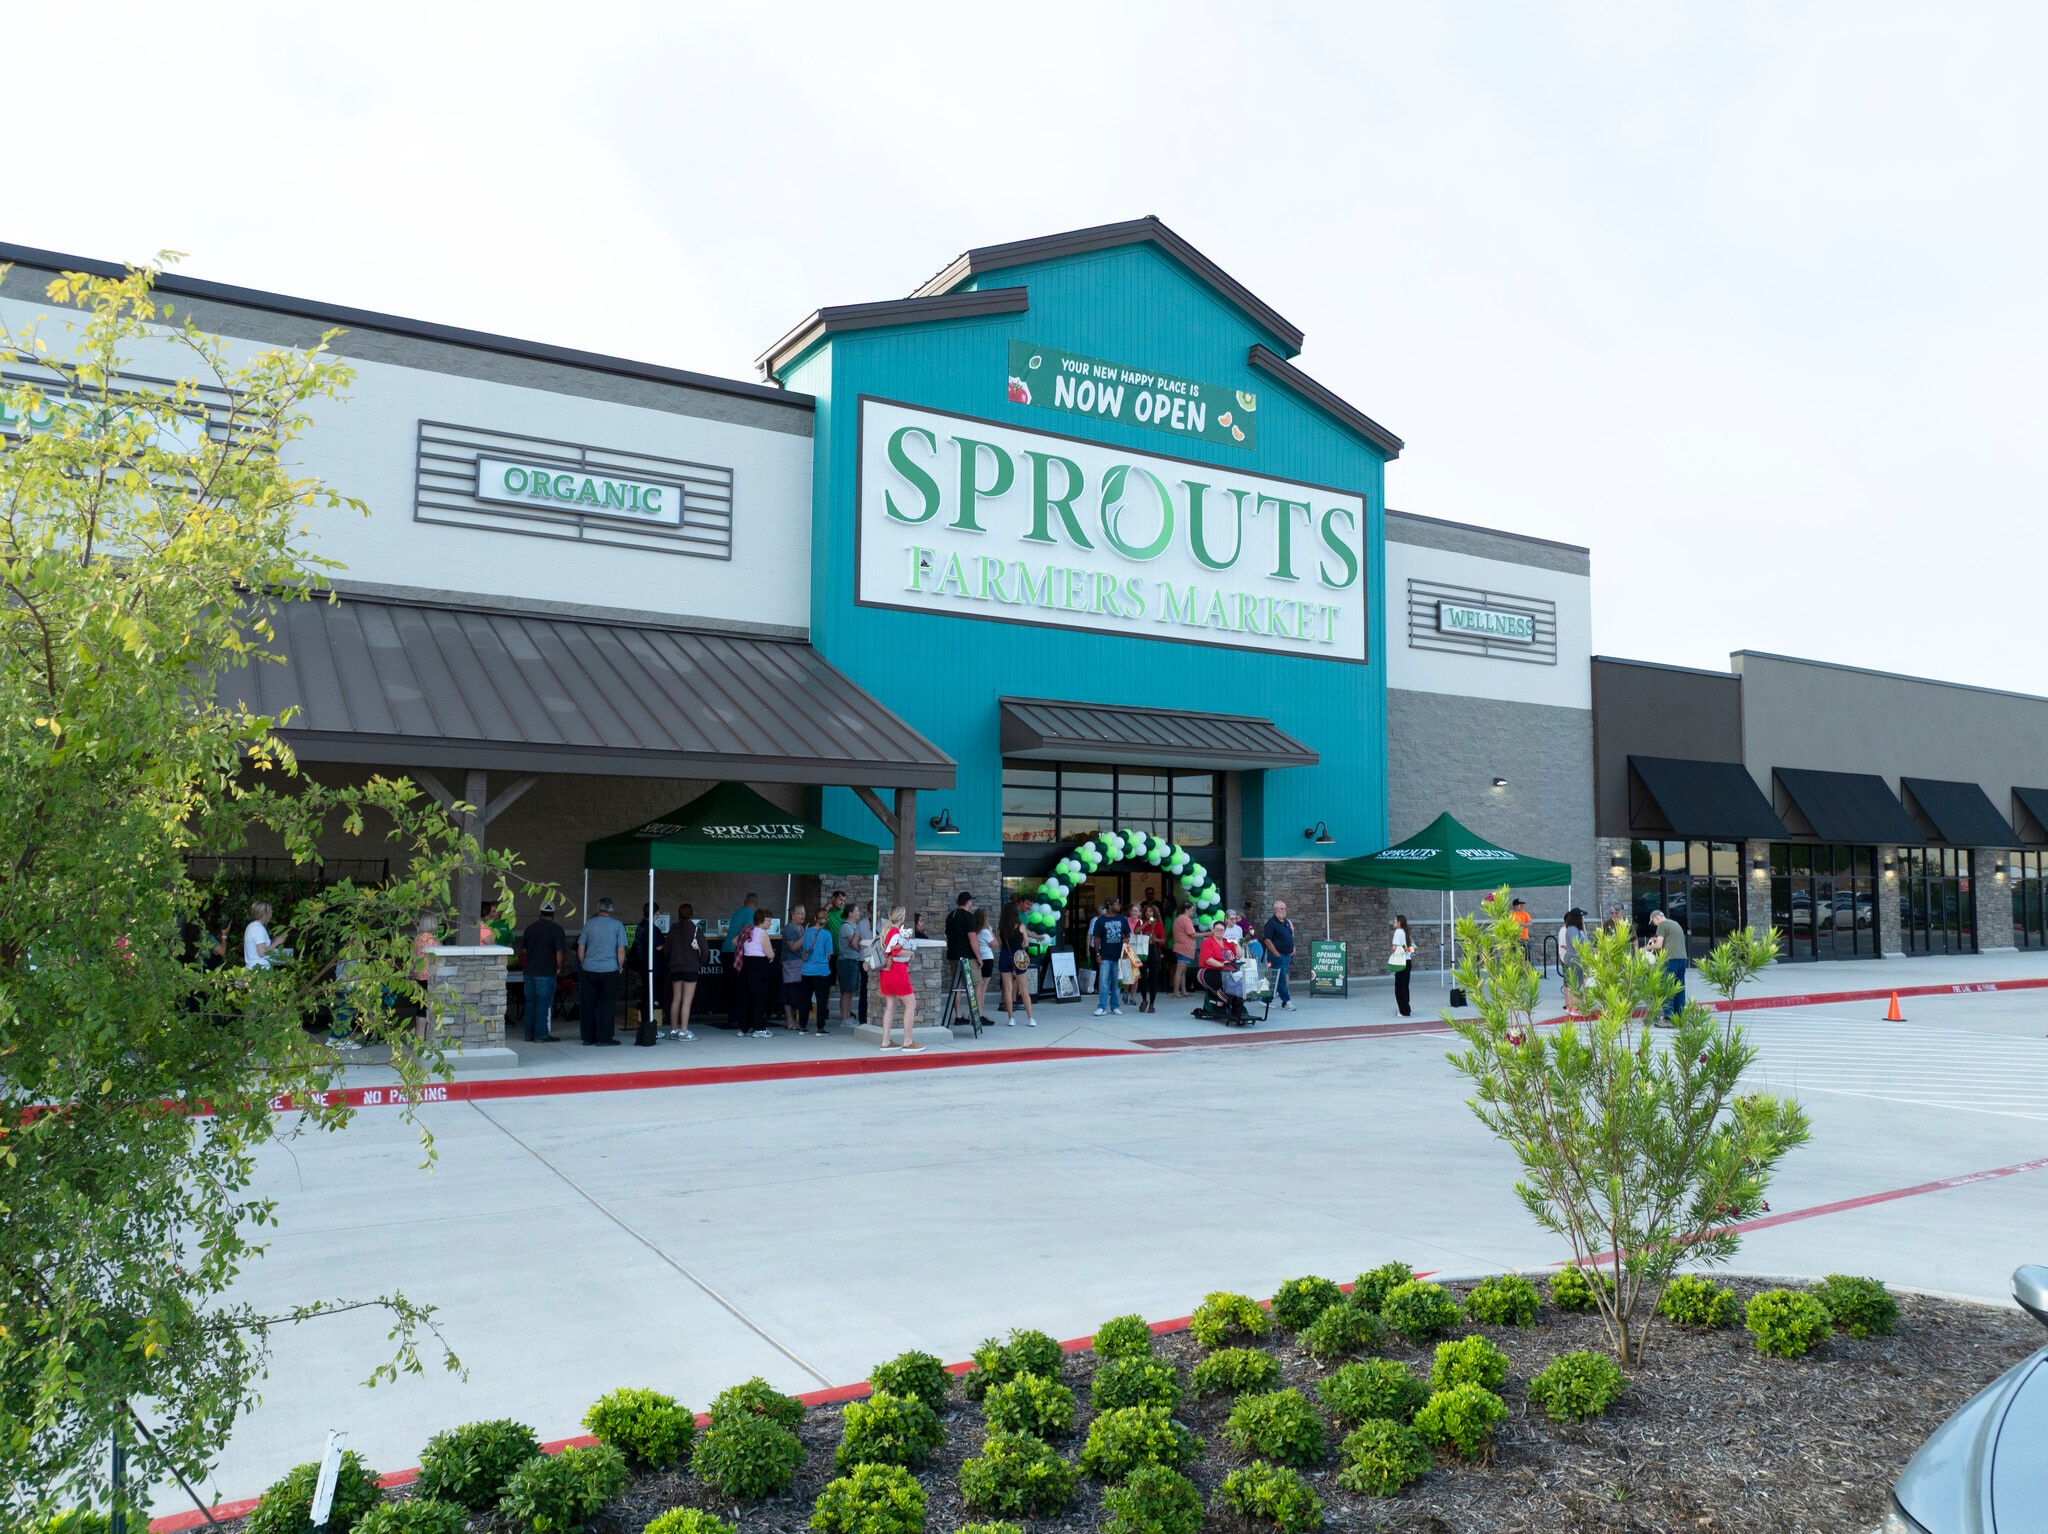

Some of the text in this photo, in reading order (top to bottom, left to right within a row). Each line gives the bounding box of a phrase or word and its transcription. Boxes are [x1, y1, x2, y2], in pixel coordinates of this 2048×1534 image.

[1061, 358, 1200, 397] YOUR NEW HAPPY PLACE IS
[1054, 375, 1206, 433] NOW OPEN
[503, 467, 663, 514] ORGANIC
[884, 427, 1358, 589] SPROUTS
[905, 545, 1342, 643] FARMERS MARKET
[1448, 607, 1534, 636] WELLNESS
[702, 824, 805, 835] SPROUTS
[1378, 848, 1440, 857] SPROUTS
[1316, 951, 1342, 959] OPENING
[363, 1090, 382, 1105] NO
[389, 1087, 447, 1103] PAKING
